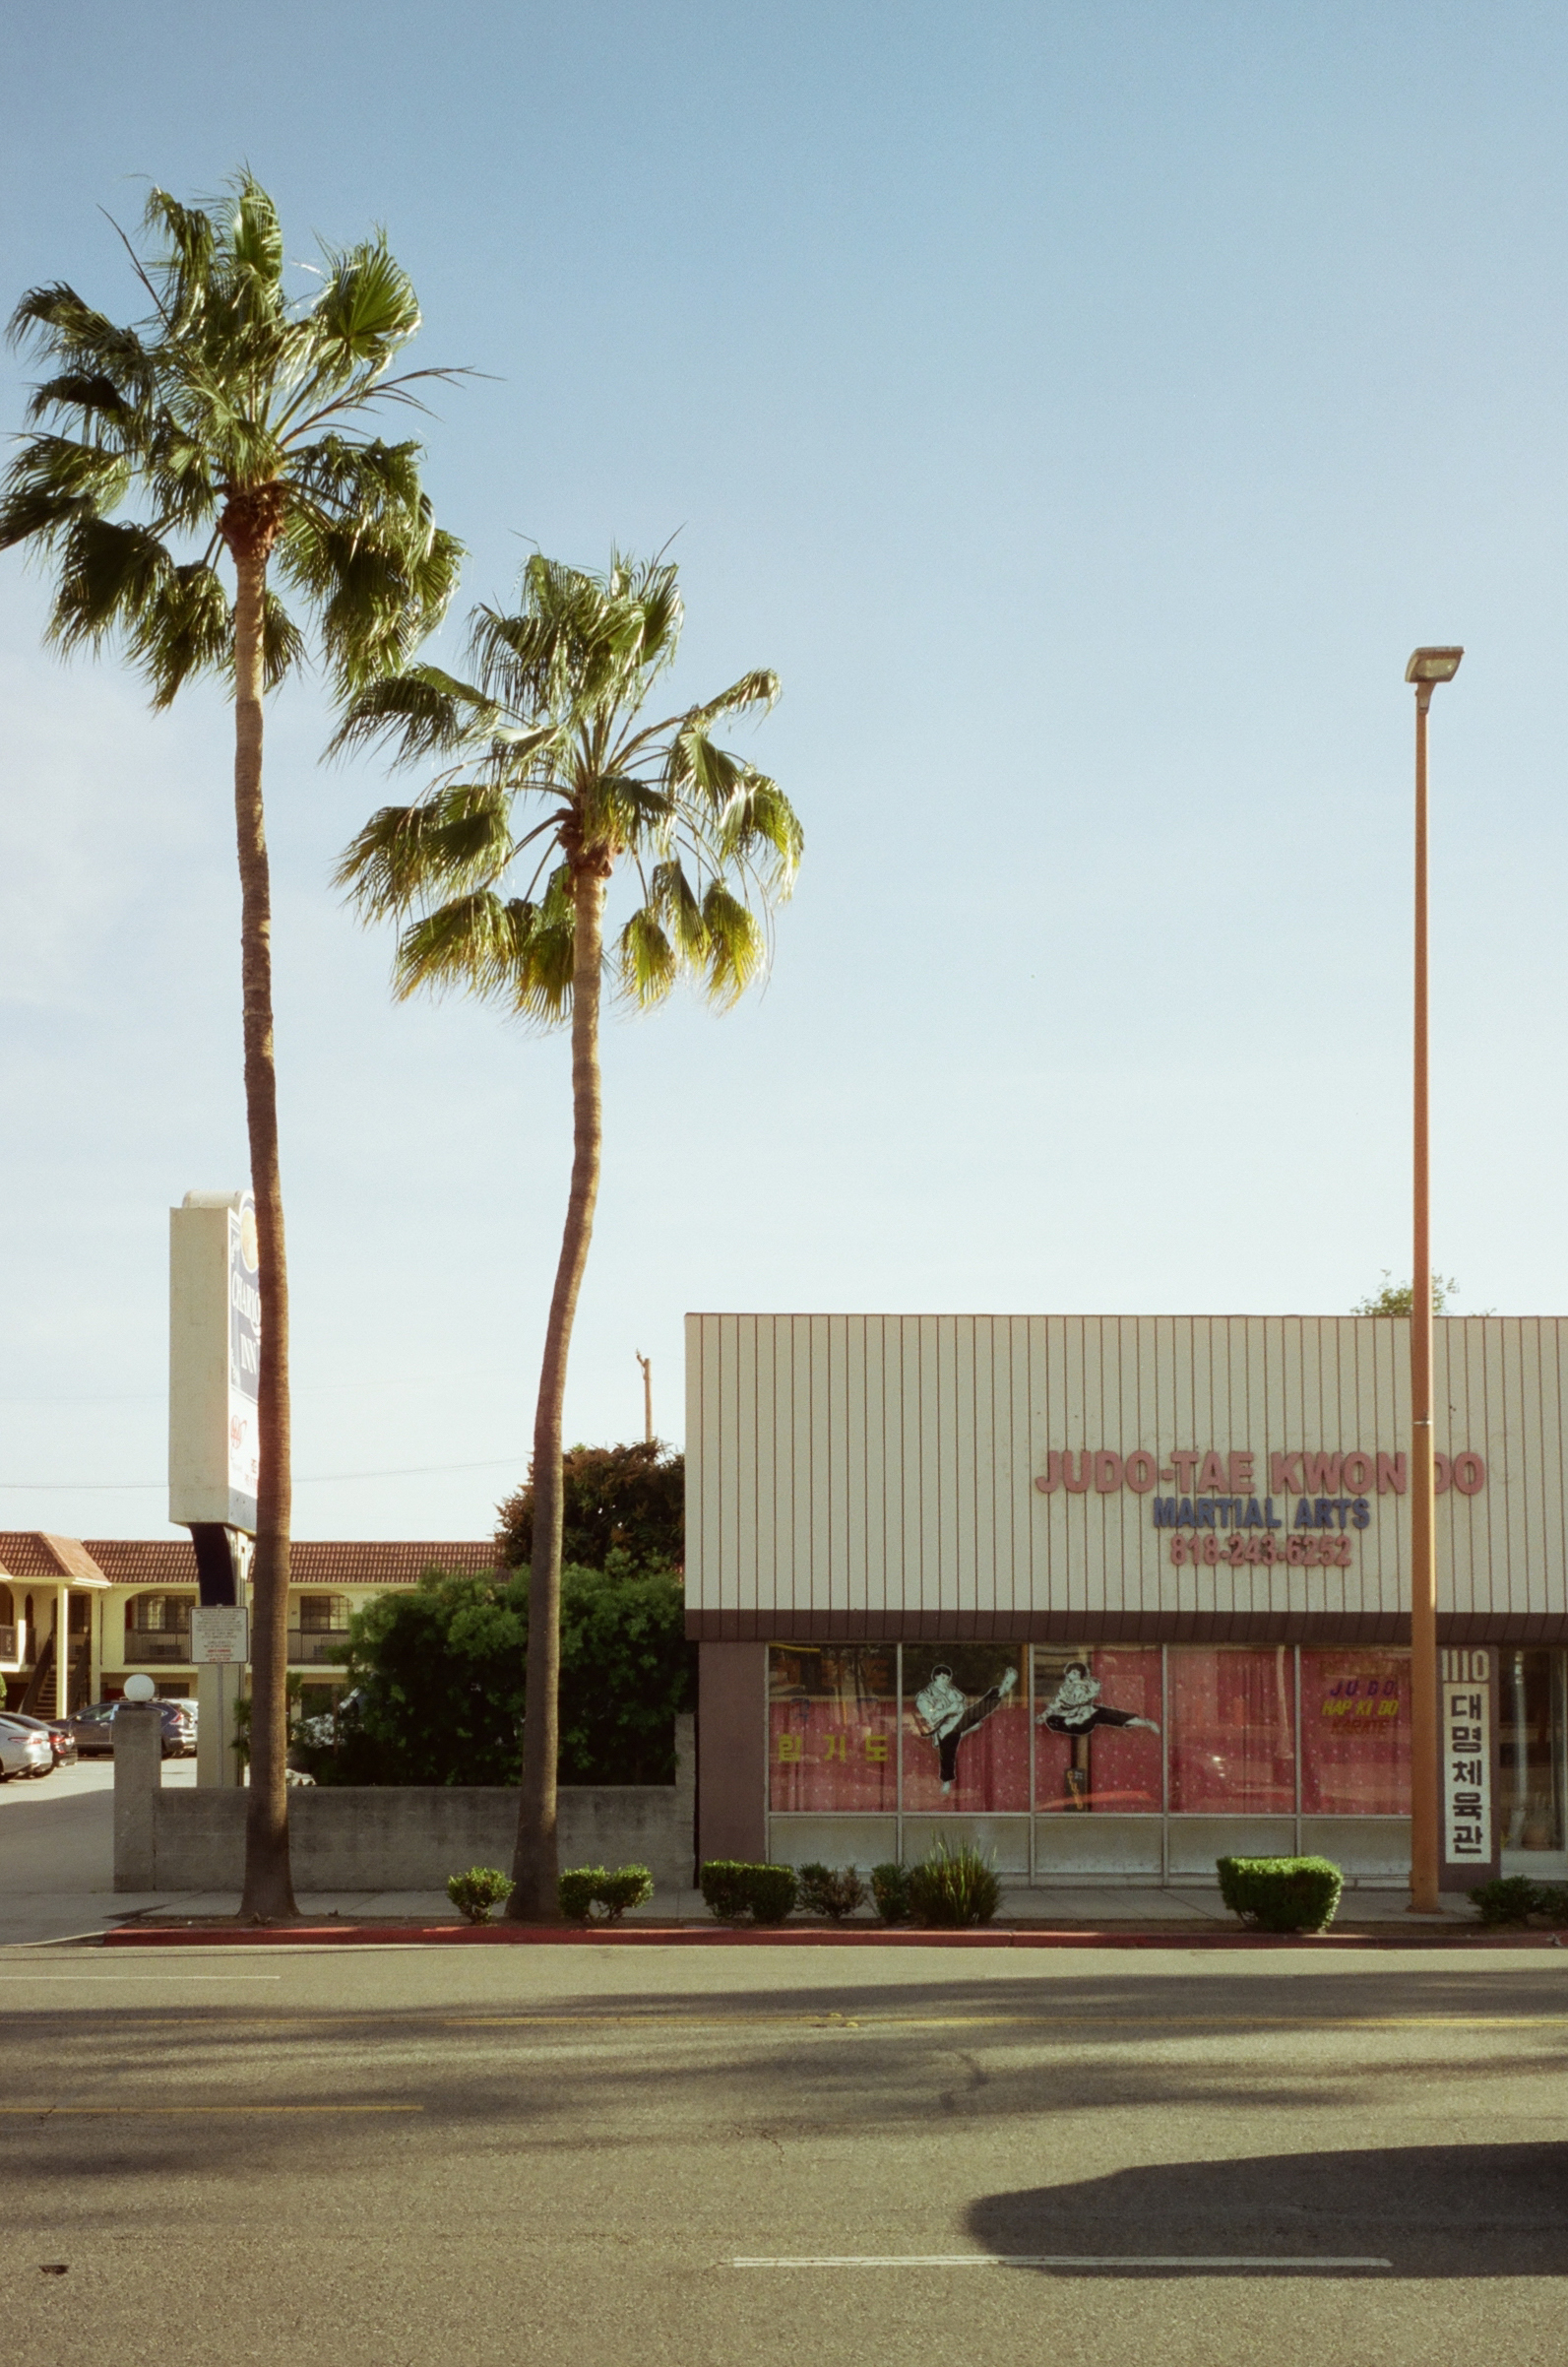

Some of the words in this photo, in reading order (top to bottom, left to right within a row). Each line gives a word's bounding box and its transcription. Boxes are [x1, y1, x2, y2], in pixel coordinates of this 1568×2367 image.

[232, 1270, 261, 1327] CHARIO
[1035, 1450, 1255, 1494] JUDO-TAE
[1271, 1451, 1407, 1495] KWON
[1433, 1451, 1485, 1495] DO
[1153, 1497, 1282, 1528] MARTIAL
[1293, 1498, 1370, 1529] ARTS
[1169, 1534, 1352, 1567] 818-243-6252
[1441, 1649, 1490, 1682] 1110
[1451, 1694, 1483, 1854] 대명체육관
